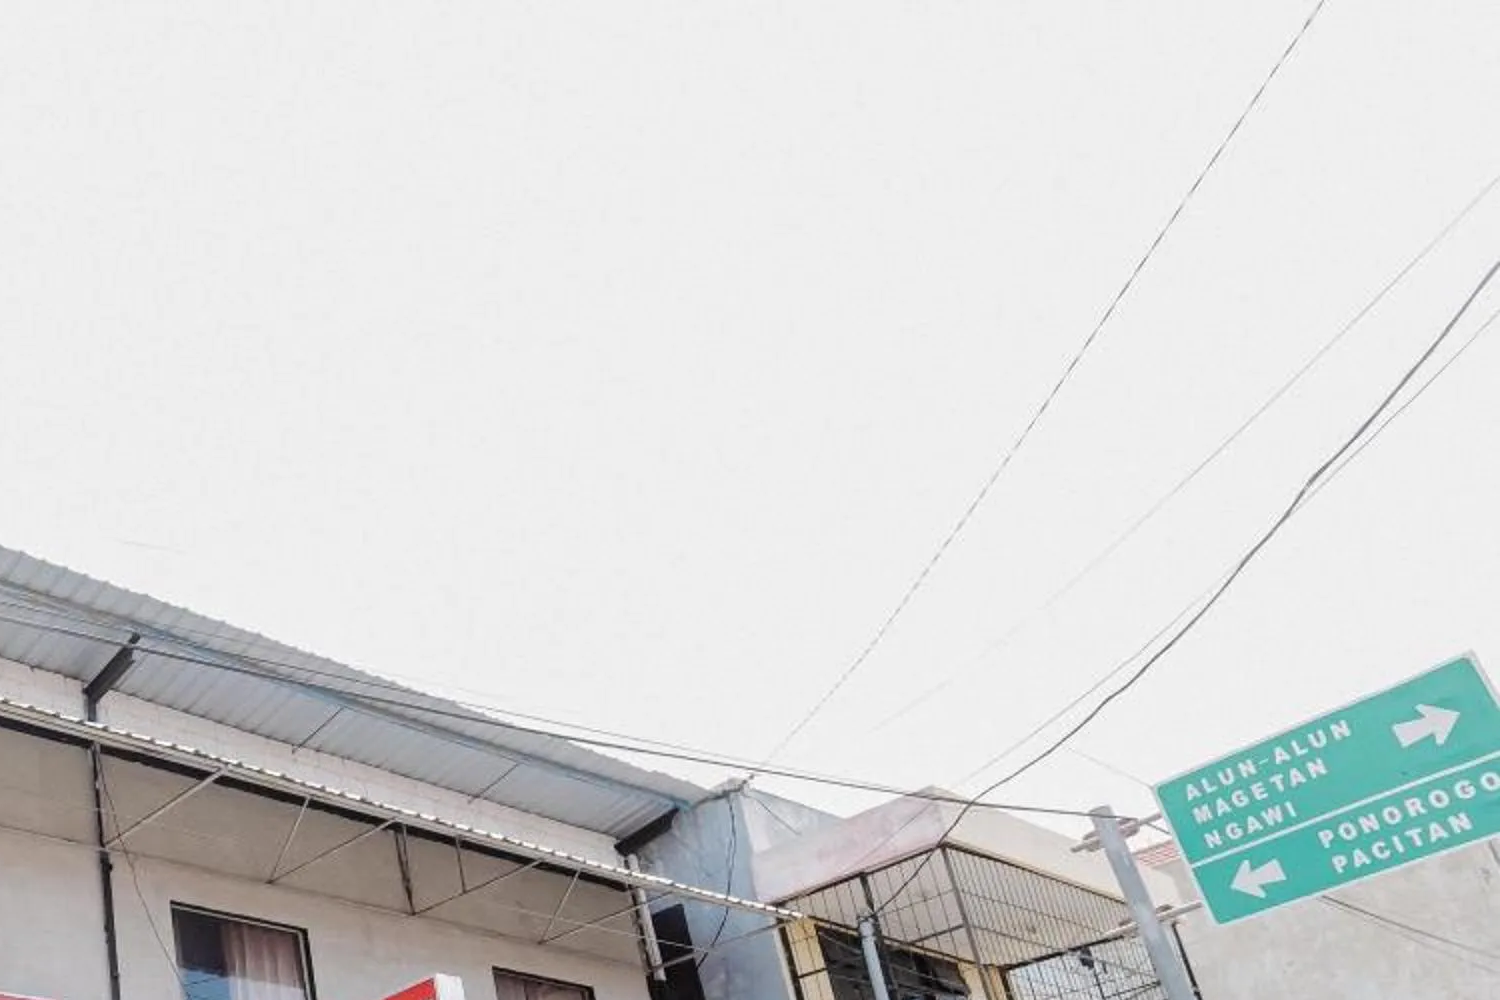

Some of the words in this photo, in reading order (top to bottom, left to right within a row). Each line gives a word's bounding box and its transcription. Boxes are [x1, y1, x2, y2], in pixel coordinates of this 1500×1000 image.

[1191, 757, 1328, 825] MAGETAN
[1316, 770, 1500, 849] PONOROGO
[1203, 801, 1297, 849] NGAWI
[1330, 812, 1474, 874] PACITAN
